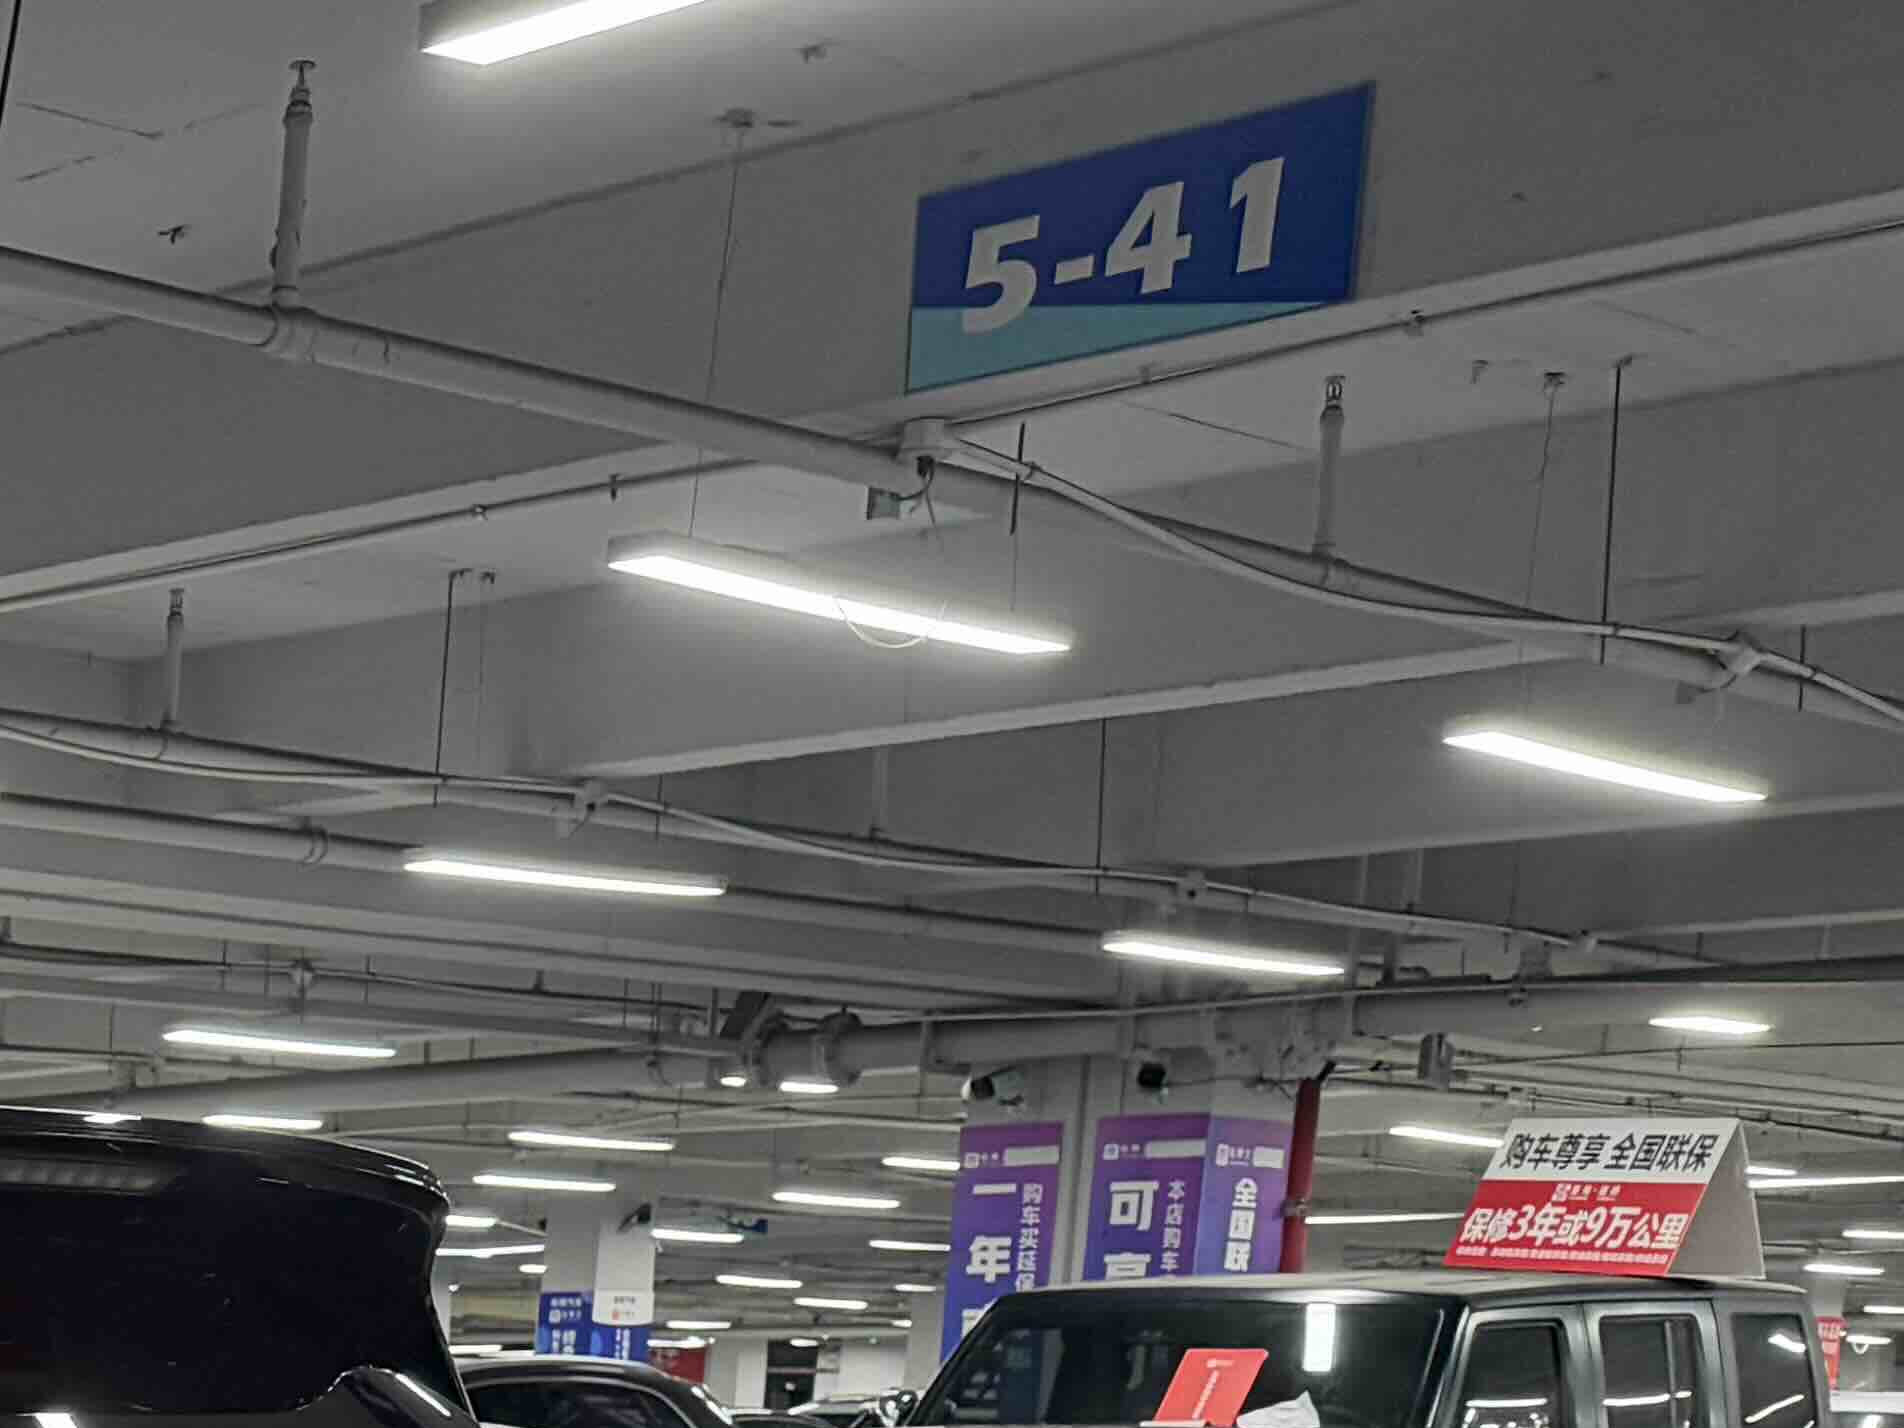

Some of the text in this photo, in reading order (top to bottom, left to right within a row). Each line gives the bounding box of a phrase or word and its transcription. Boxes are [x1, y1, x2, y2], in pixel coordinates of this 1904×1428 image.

[961, 155, 1287, 335] 5-41
[1501, 1133, 1720, 1173] 购车尊享 全国联保
[1160, 1180, 1187, 1281] 本店购车
[1459, 1204, 1690, 1250] 保修3年或9万公里
